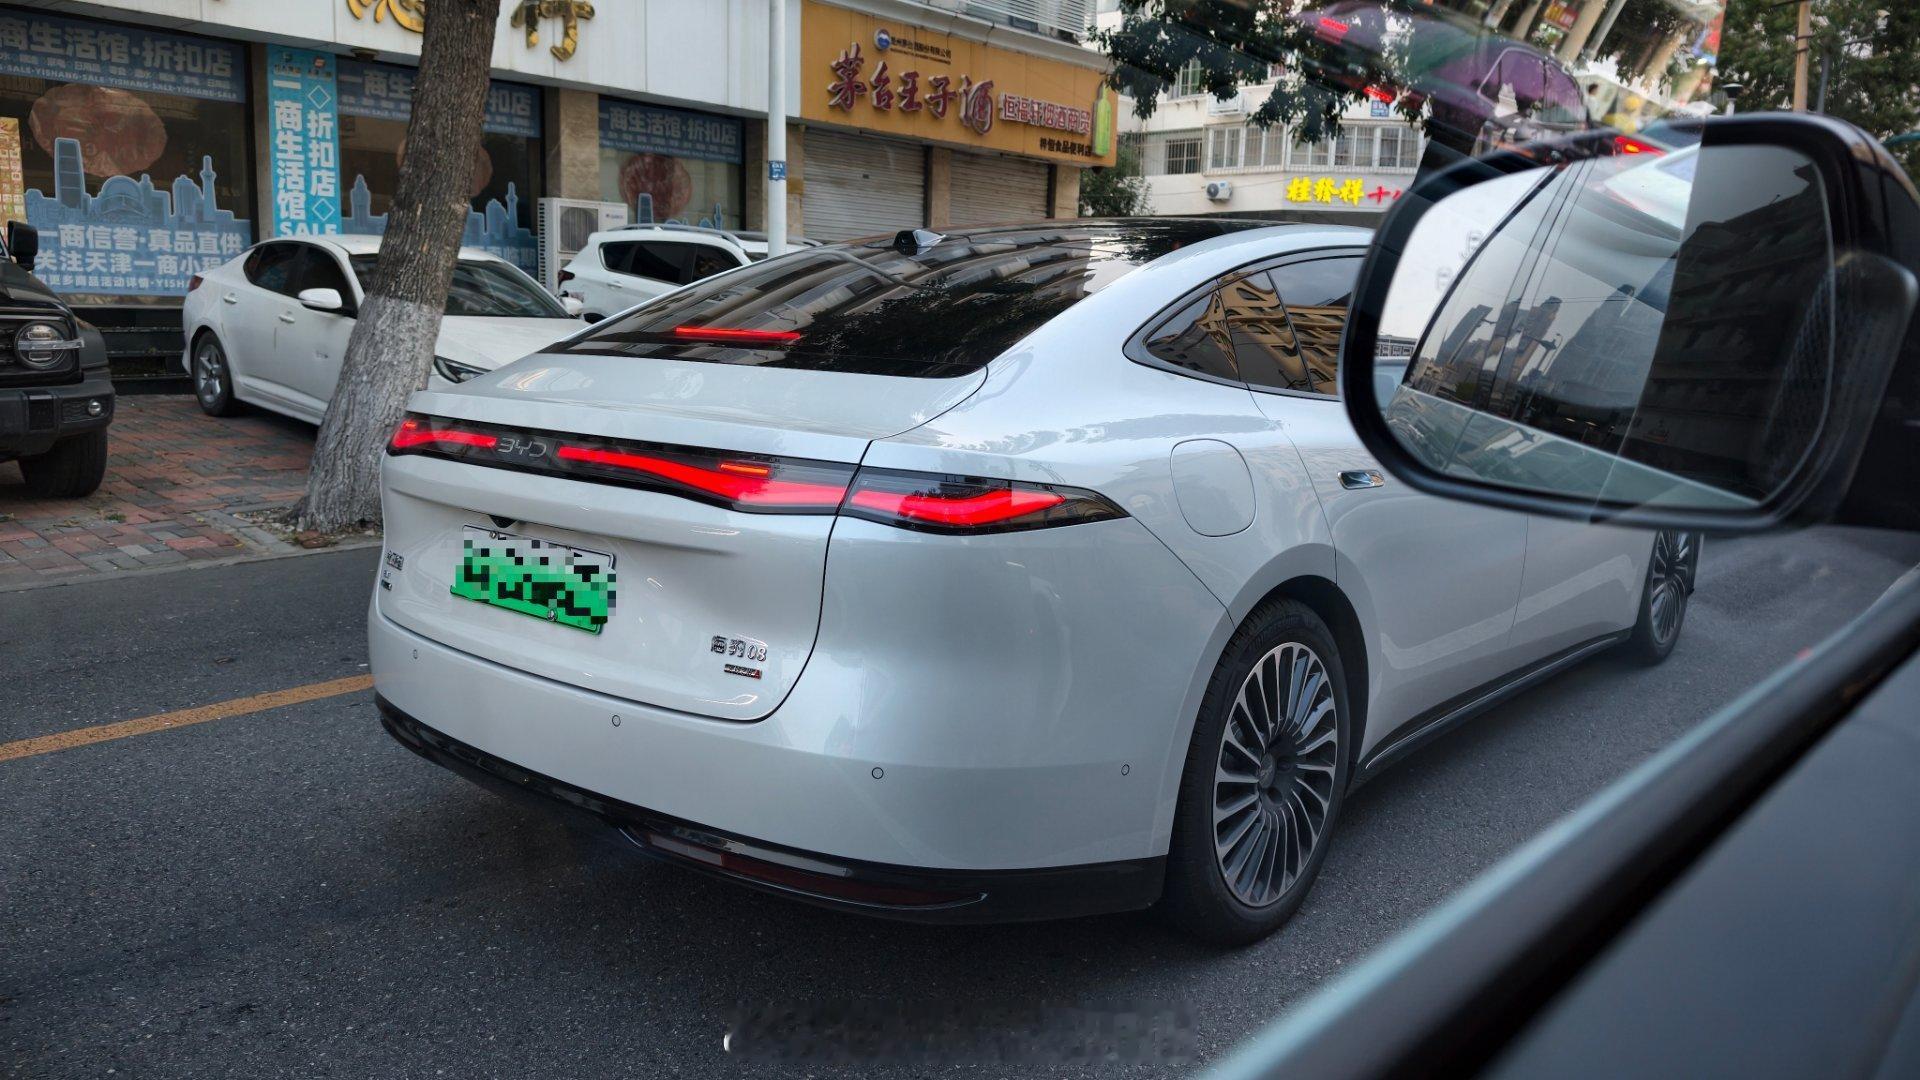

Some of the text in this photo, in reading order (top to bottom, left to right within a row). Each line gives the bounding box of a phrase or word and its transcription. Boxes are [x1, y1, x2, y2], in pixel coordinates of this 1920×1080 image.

[828, 42, 994, 135] 茅台王子酒
[307, 109, 336, 197] 折扣店
[498, 437, 546, 457] BYD
